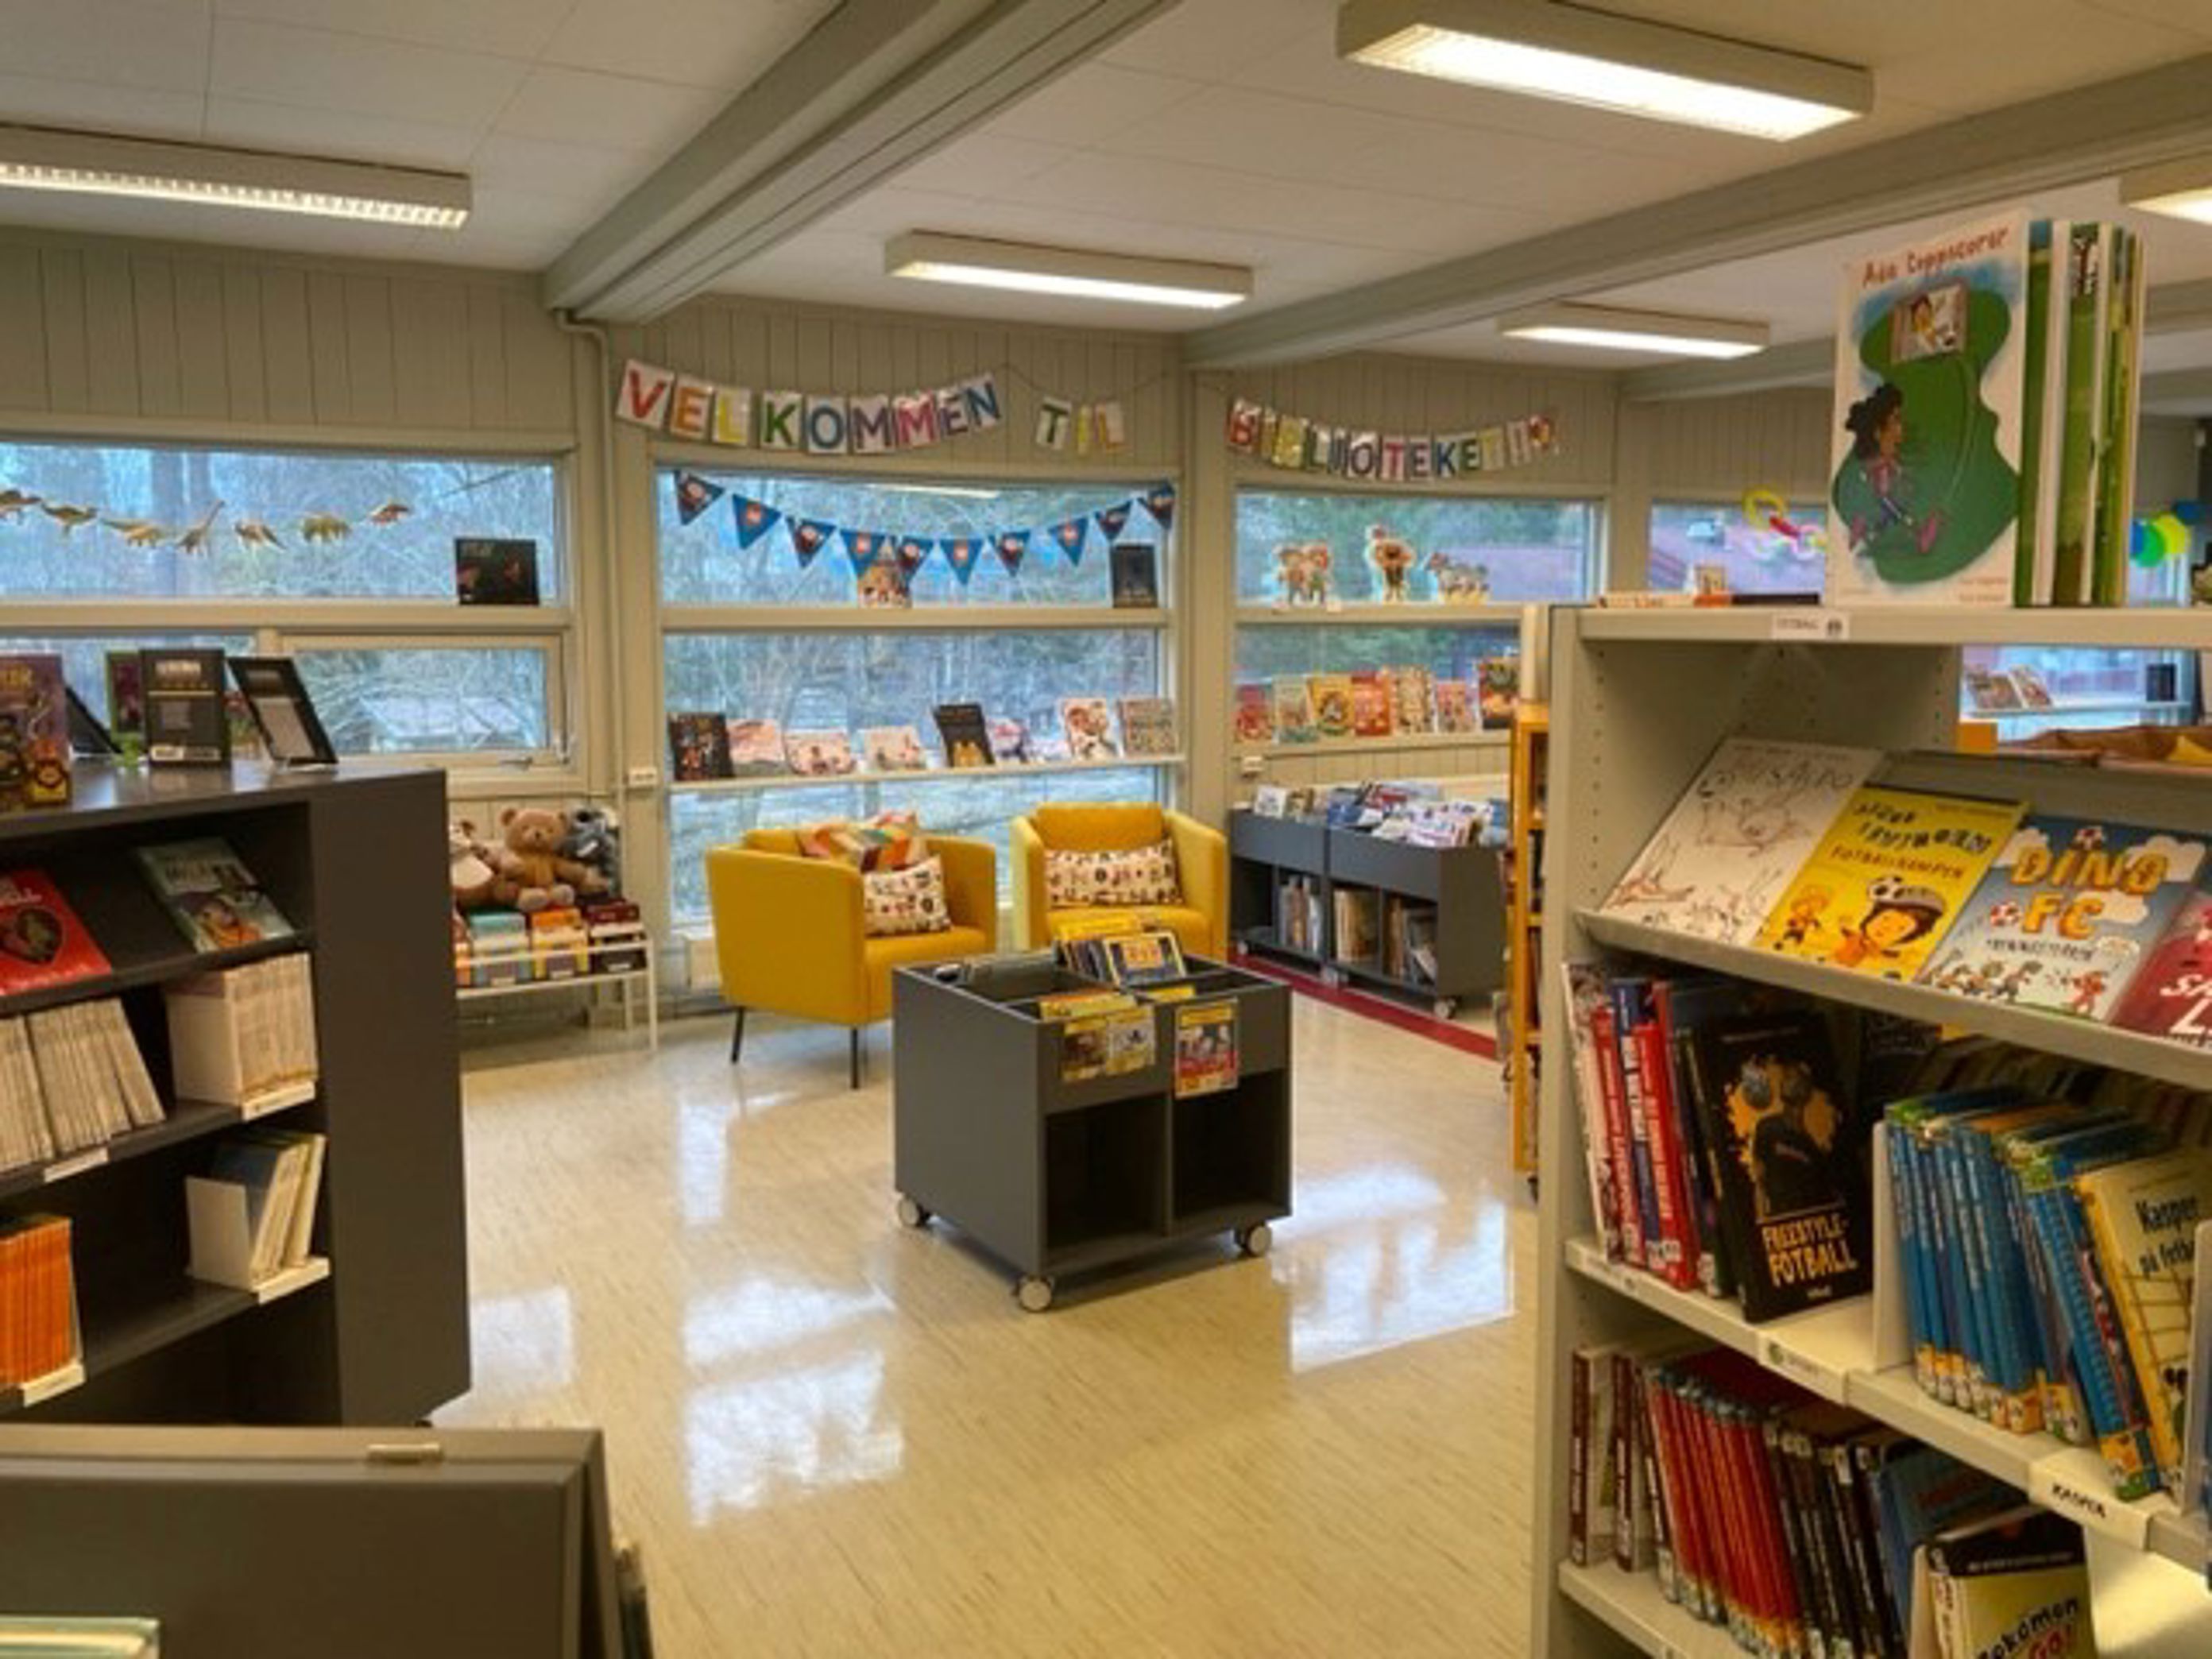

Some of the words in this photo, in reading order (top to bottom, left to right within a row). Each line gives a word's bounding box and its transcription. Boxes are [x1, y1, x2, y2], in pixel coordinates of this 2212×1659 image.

[625, 367, 1003, 450] VELKOMMEN
[1038, 401, 1127, 453] TIL
[2010, 846, 2168, 895] DINO
[2021, 890, 2106, 941] FC
[1769, 1238, 1858, 1287] FOTBALL
